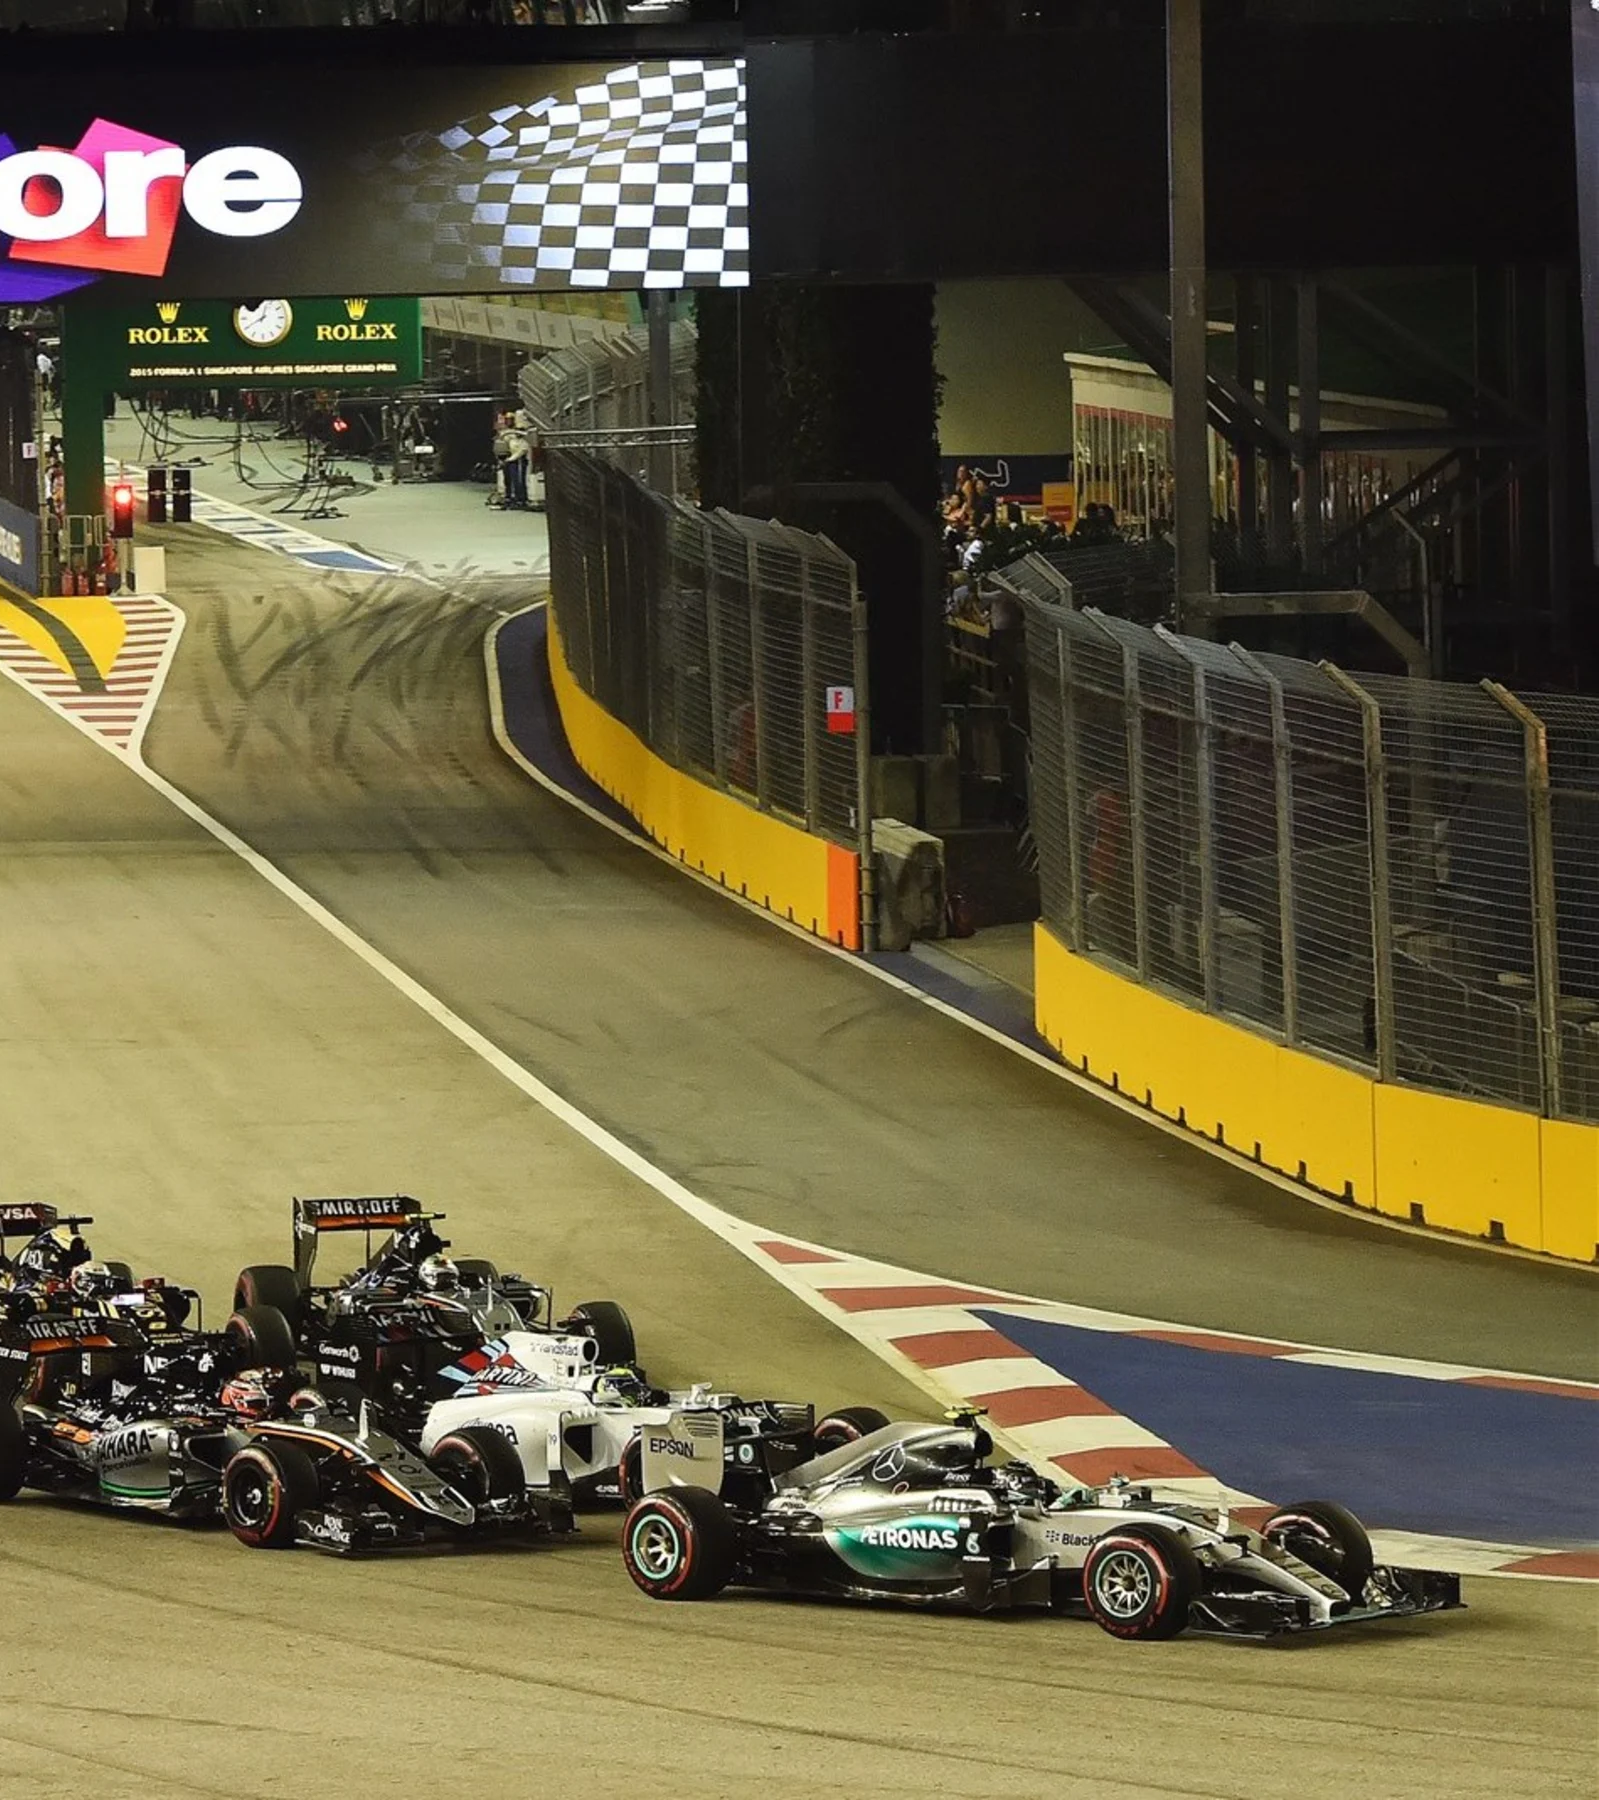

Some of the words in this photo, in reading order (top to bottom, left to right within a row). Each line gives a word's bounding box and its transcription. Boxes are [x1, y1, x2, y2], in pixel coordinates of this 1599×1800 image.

[129, 328, 209, 344] ROLEX
[317, 324, 397, 340] ROLEX
[154, 367, 195, 376] FORMULA
[204, 366, 253, 375] SINGAPORE
[254, 365, 292, 374] AIRLINES
[294, 365, 343, 373] SINGAPORE
[344, 364, 375, 373] GRAND
[376, 363, 397, 372] PRIX
[834, 690, 843, 709] F
[471, 1366, 538, 1386] ARTINI
[650, 1437, 694, 1458] EPSON
[860, 1526, 958, 1550] PETRONAS
[965, 1532, 980, 1555] 6
